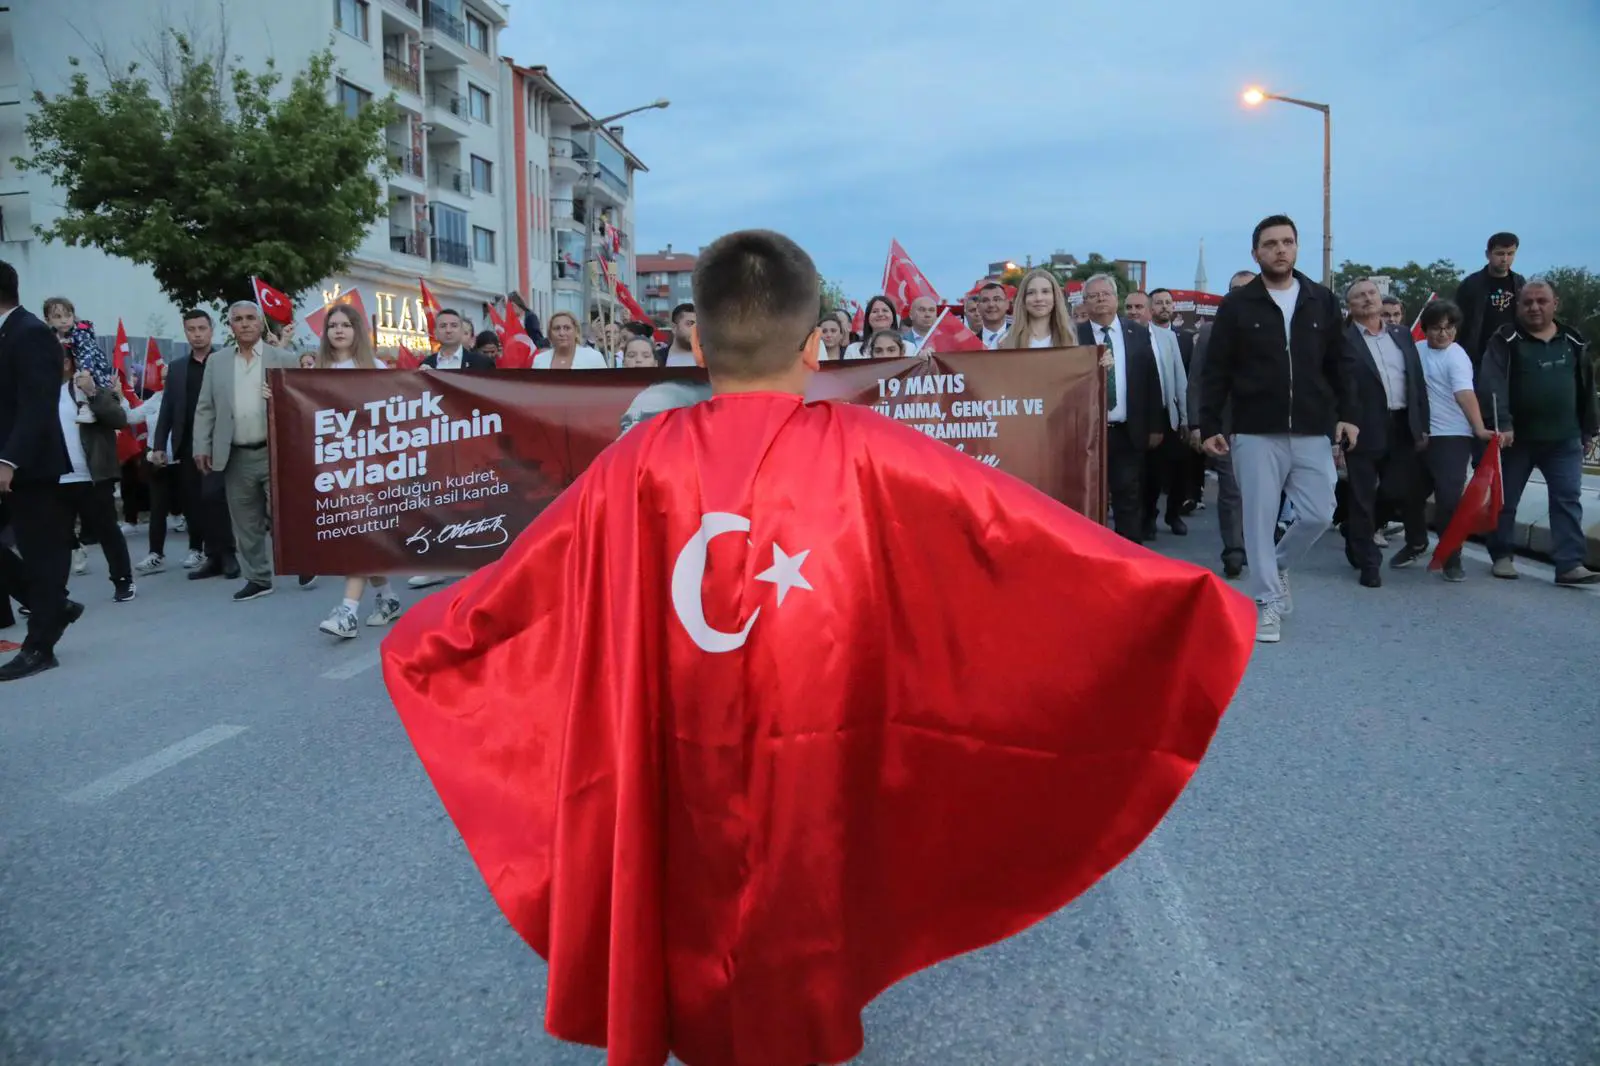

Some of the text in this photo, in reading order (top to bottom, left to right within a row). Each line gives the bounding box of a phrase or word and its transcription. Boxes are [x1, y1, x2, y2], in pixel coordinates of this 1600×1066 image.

[877, 374, 965, 398] 19 MAYIS
[315, 391, 444, 438] Ey Türk
[893, 402, 946, 421] ANMA,
[951, 395, 1017, 420] GENÇLİK
[1023, 398, 1044, 416] VE
[314, 408, 502, 465] istikbalinin
[314, 450, 427, 493] evladı!
[316, 469, 499, 511] Muhtaç olduğun kudret,
[316, 482, 509, 526] damarlarındaki asil kanda
[317, 515, 399, 541] mevcuttur!
